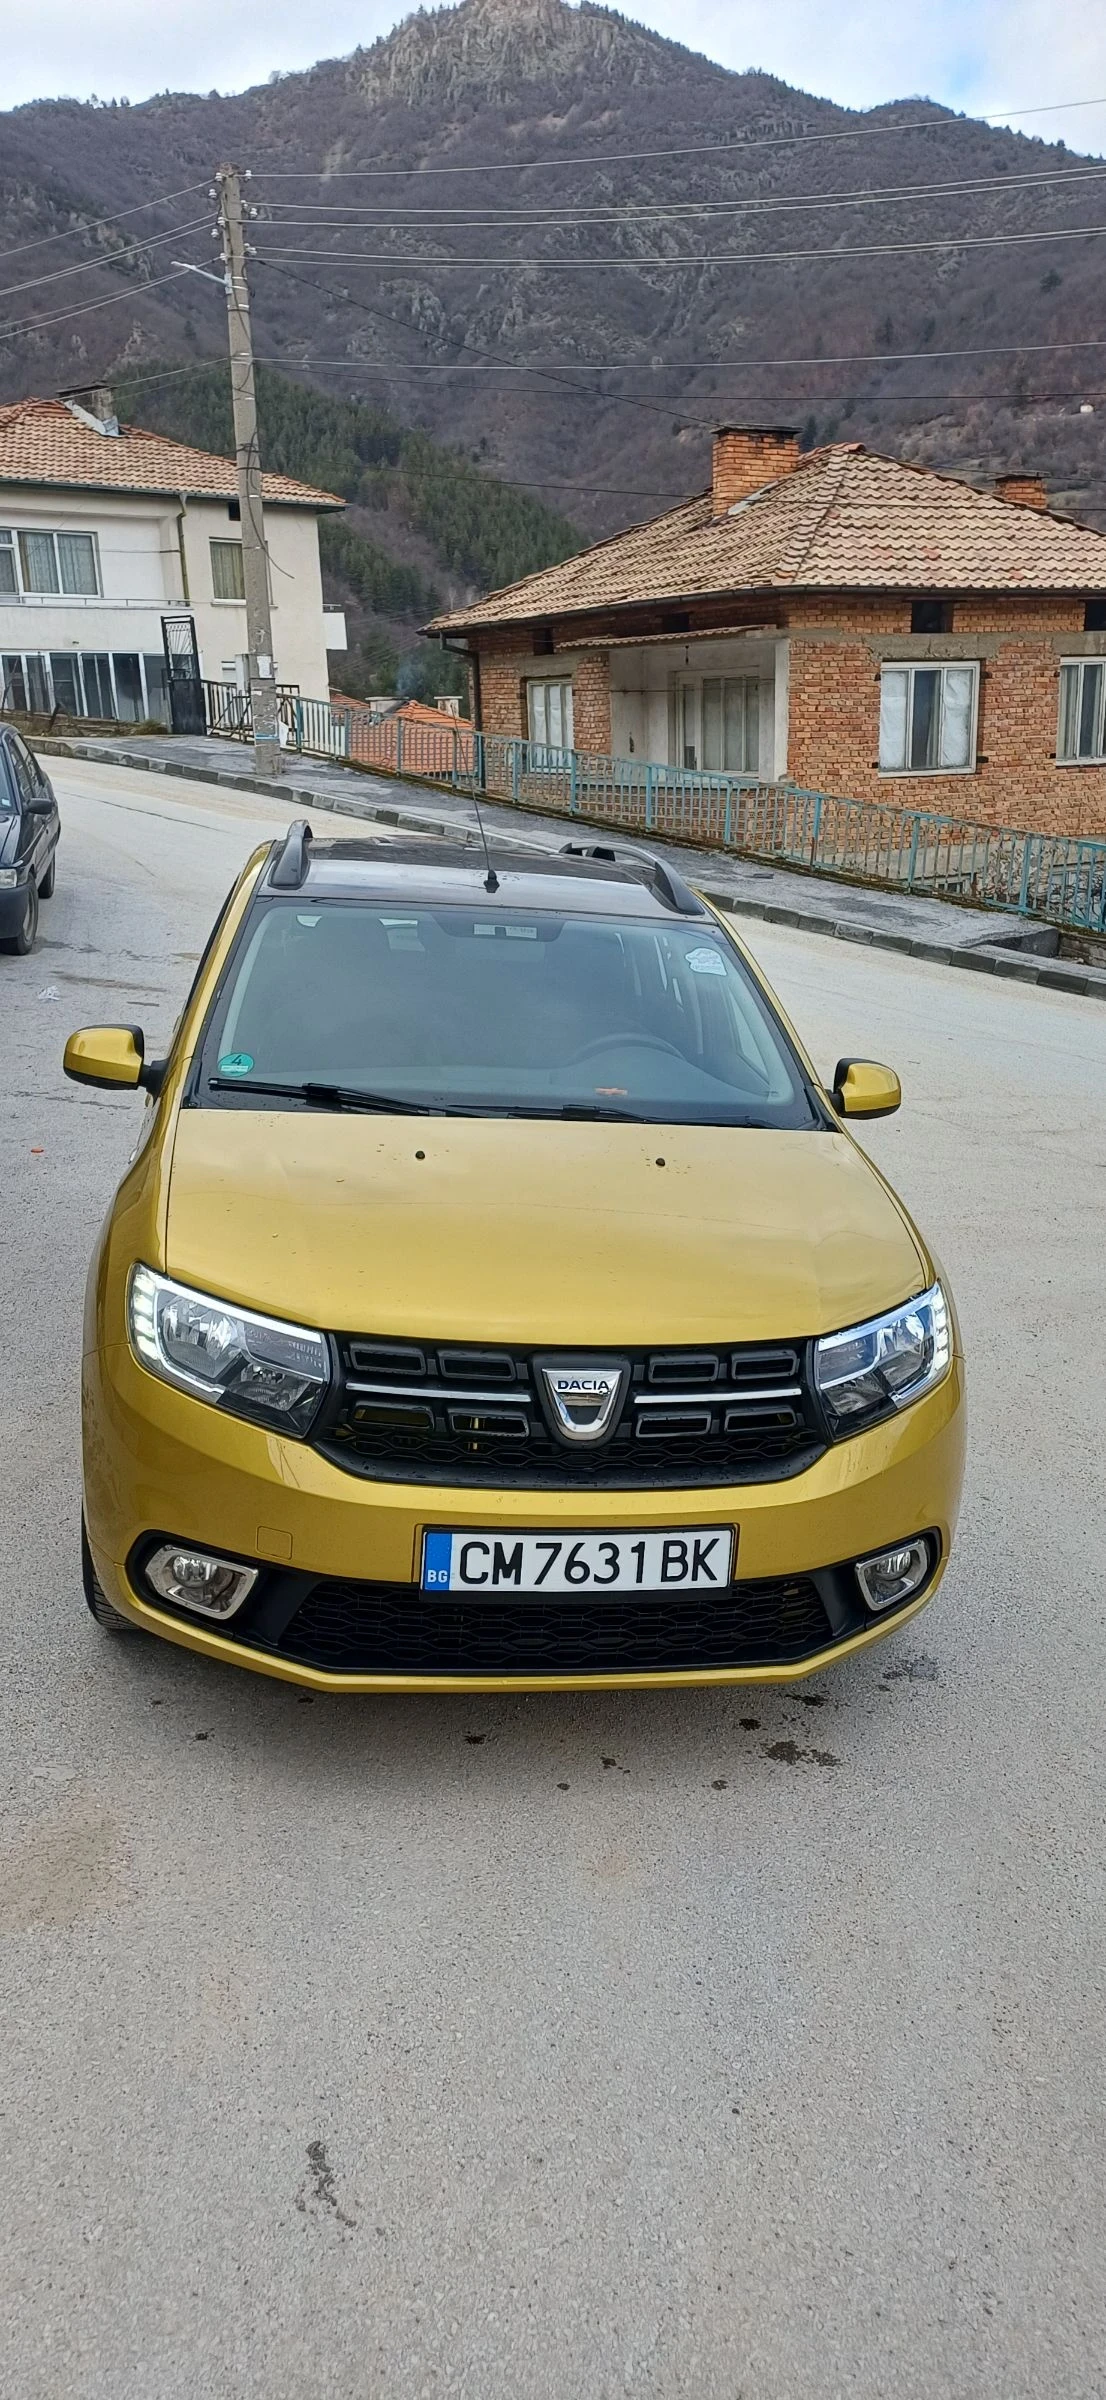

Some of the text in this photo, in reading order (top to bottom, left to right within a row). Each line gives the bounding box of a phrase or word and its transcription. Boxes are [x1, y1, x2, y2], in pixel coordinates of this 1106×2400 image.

[231, 1054, 242, 1065] 4
[557, 1380, 609, 1390] DACIA
[459, 1538, 720, 1585] CM 7631 BK
[427, 1569, 448, 1583] BG
